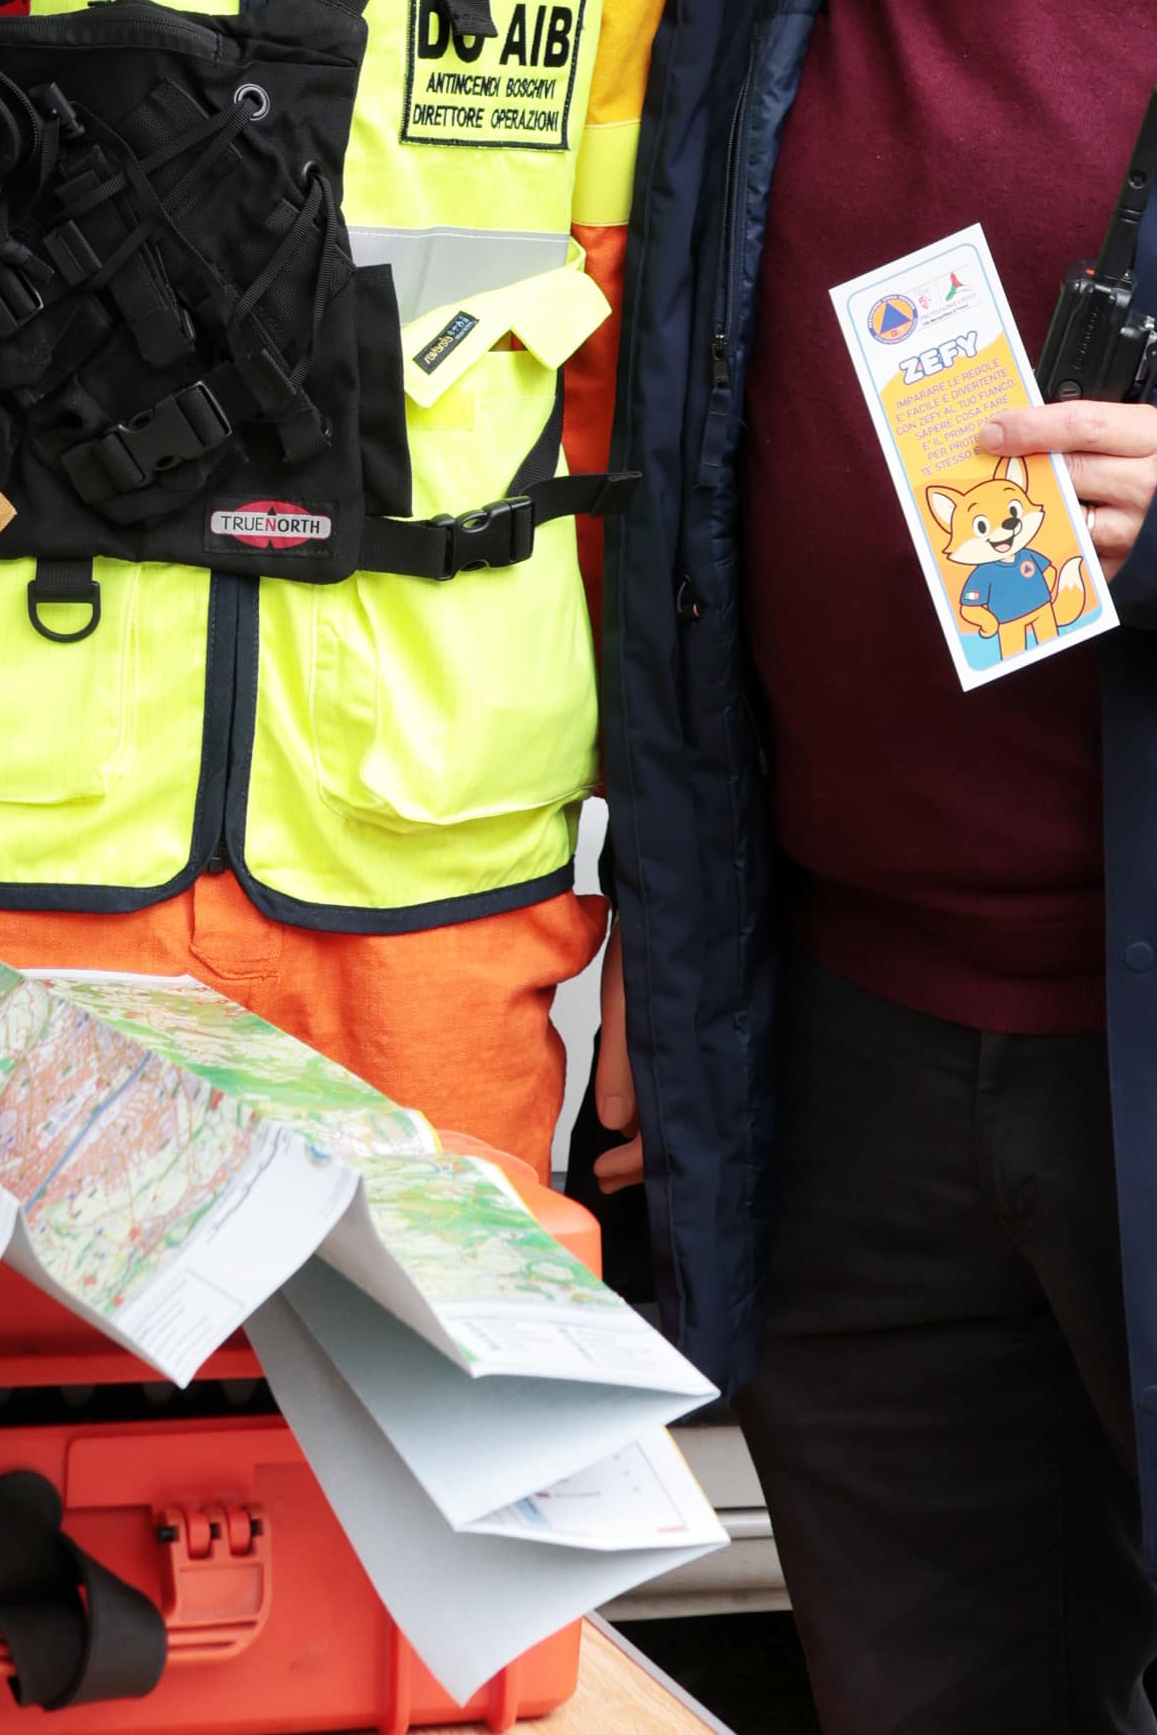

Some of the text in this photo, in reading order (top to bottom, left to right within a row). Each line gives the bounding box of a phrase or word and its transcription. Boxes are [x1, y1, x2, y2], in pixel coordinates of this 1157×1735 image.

[499, 3, 573, 67] AIB
[426, 72, 556, 99] ANTINCENDI BOSCHIVI
[412, 104, 559, 132] DIRETTORE OPERAZIONI
[899, 330, 977, 384] ZEFY
[896, 358, 999, 408] IMPARARE LE REGOLE
[906, 398, 940, 417] FACILE
[951, 369, 1007, 399] DIVERTENTE
[896, 421, 916, 435] CON
[919, 411, 940, 426] ZEFY
[944, 405, 956, 415] AL
[958, 395, 977, 408] TUO
[915, 394, 1008, 440] SAPERE COSA FARE
[944, 423, 975, 441] PRIMO
[921, 466, 931, 476] TE
[935, 450, 972, 469] STESSO
[927, 433, 981, 460] PER PROTE
[221, 515, 320, 534] TRUENORTH
